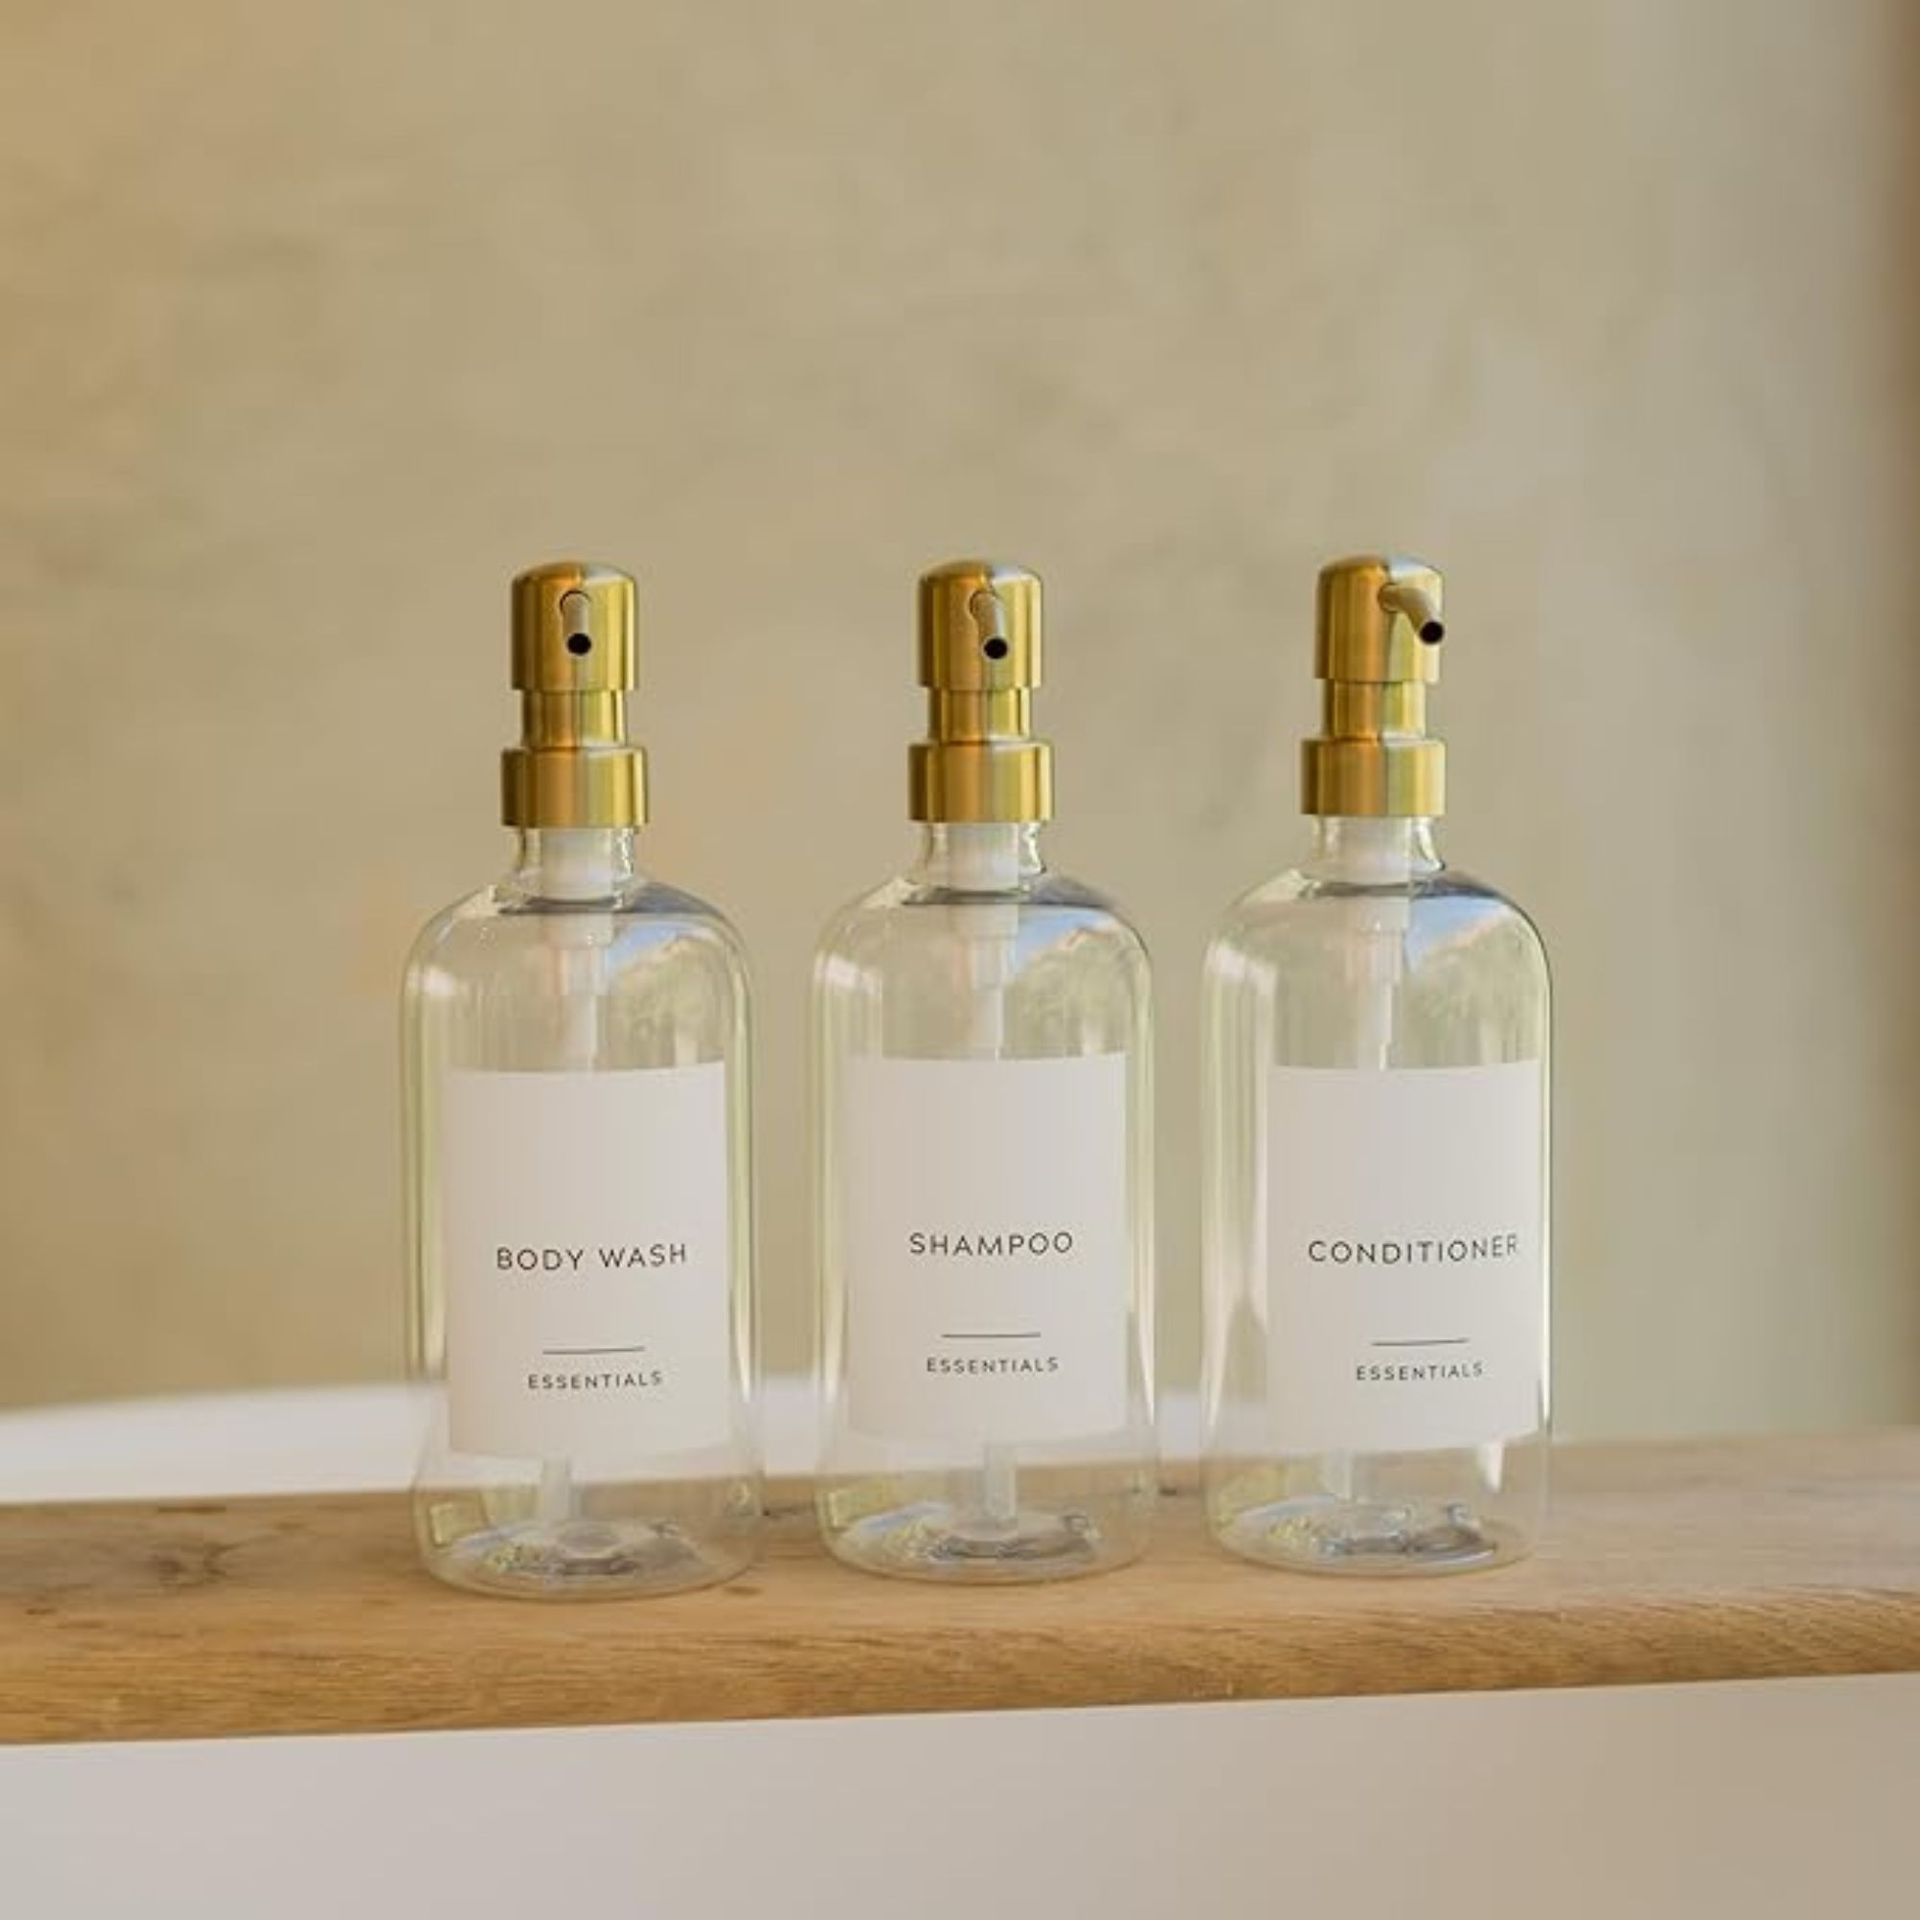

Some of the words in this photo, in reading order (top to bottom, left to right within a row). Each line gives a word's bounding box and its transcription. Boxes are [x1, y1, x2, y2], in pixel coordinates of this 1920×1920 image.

[909, 1231, 1074, 1257] SHAMPOO
[1307, 1233, 1518, 1265] CONDITIONER
[496, 1246, 584, 1271] BODY
[598, 1243, 687, 1269] WASH
[926, 1356, 1059, 1375] ESSENTIALS
[1356, 1362, 1483, 1381] ESSENTIALS
[527, 1371, 663, 1390] ESSENTIALS
